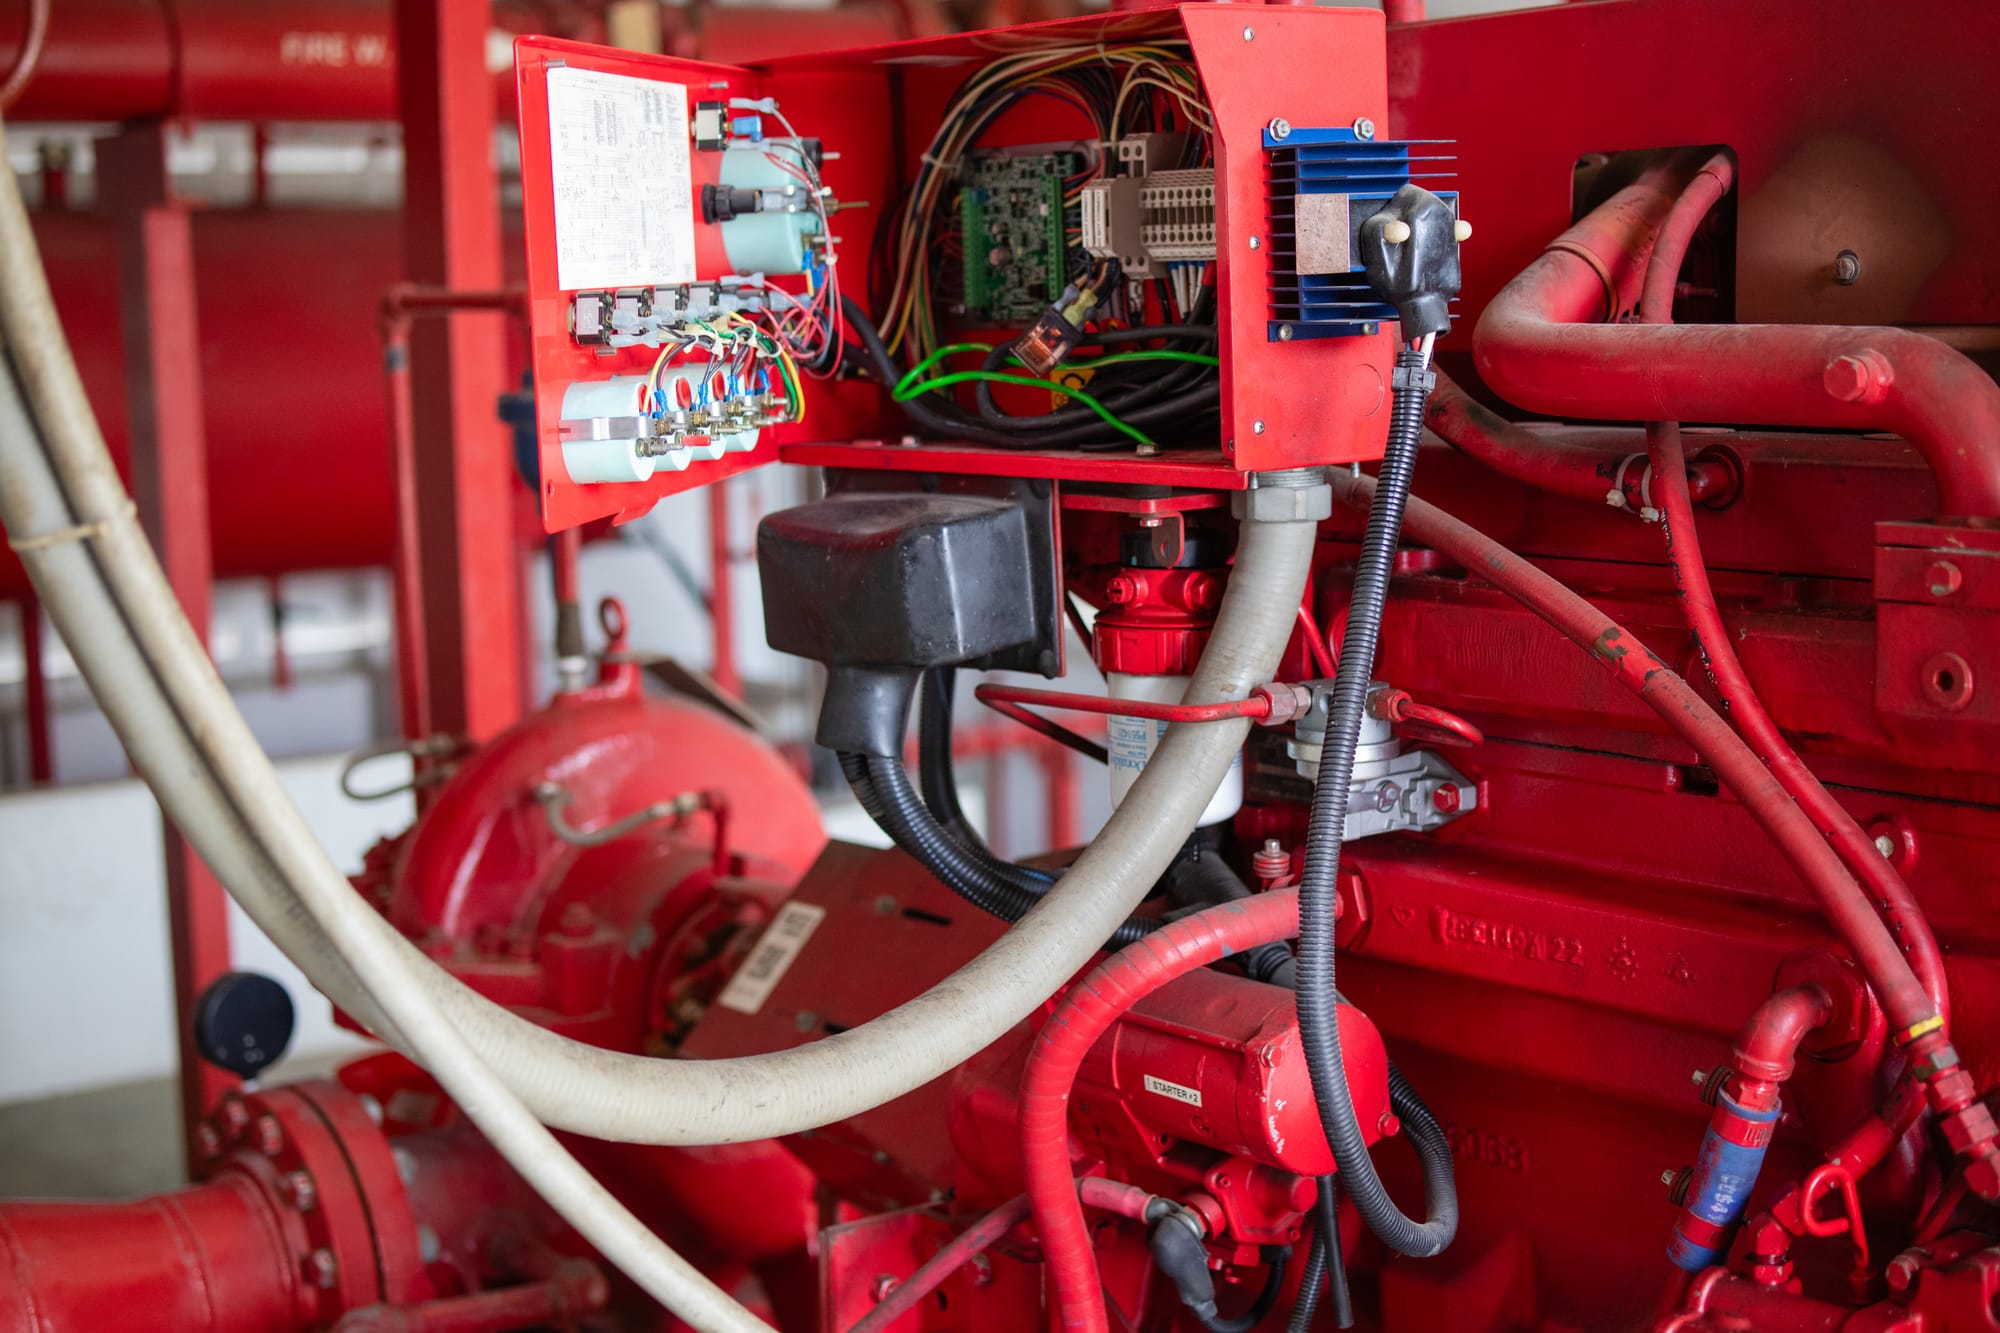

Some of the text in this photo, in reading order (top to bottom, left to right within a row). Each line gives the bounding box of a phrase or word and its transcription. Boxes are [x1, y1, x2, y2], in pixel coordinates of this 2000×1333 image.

[280, 31, 394, 67] FIRE W
[1152, 1080, 1188, 1099] STARTER
